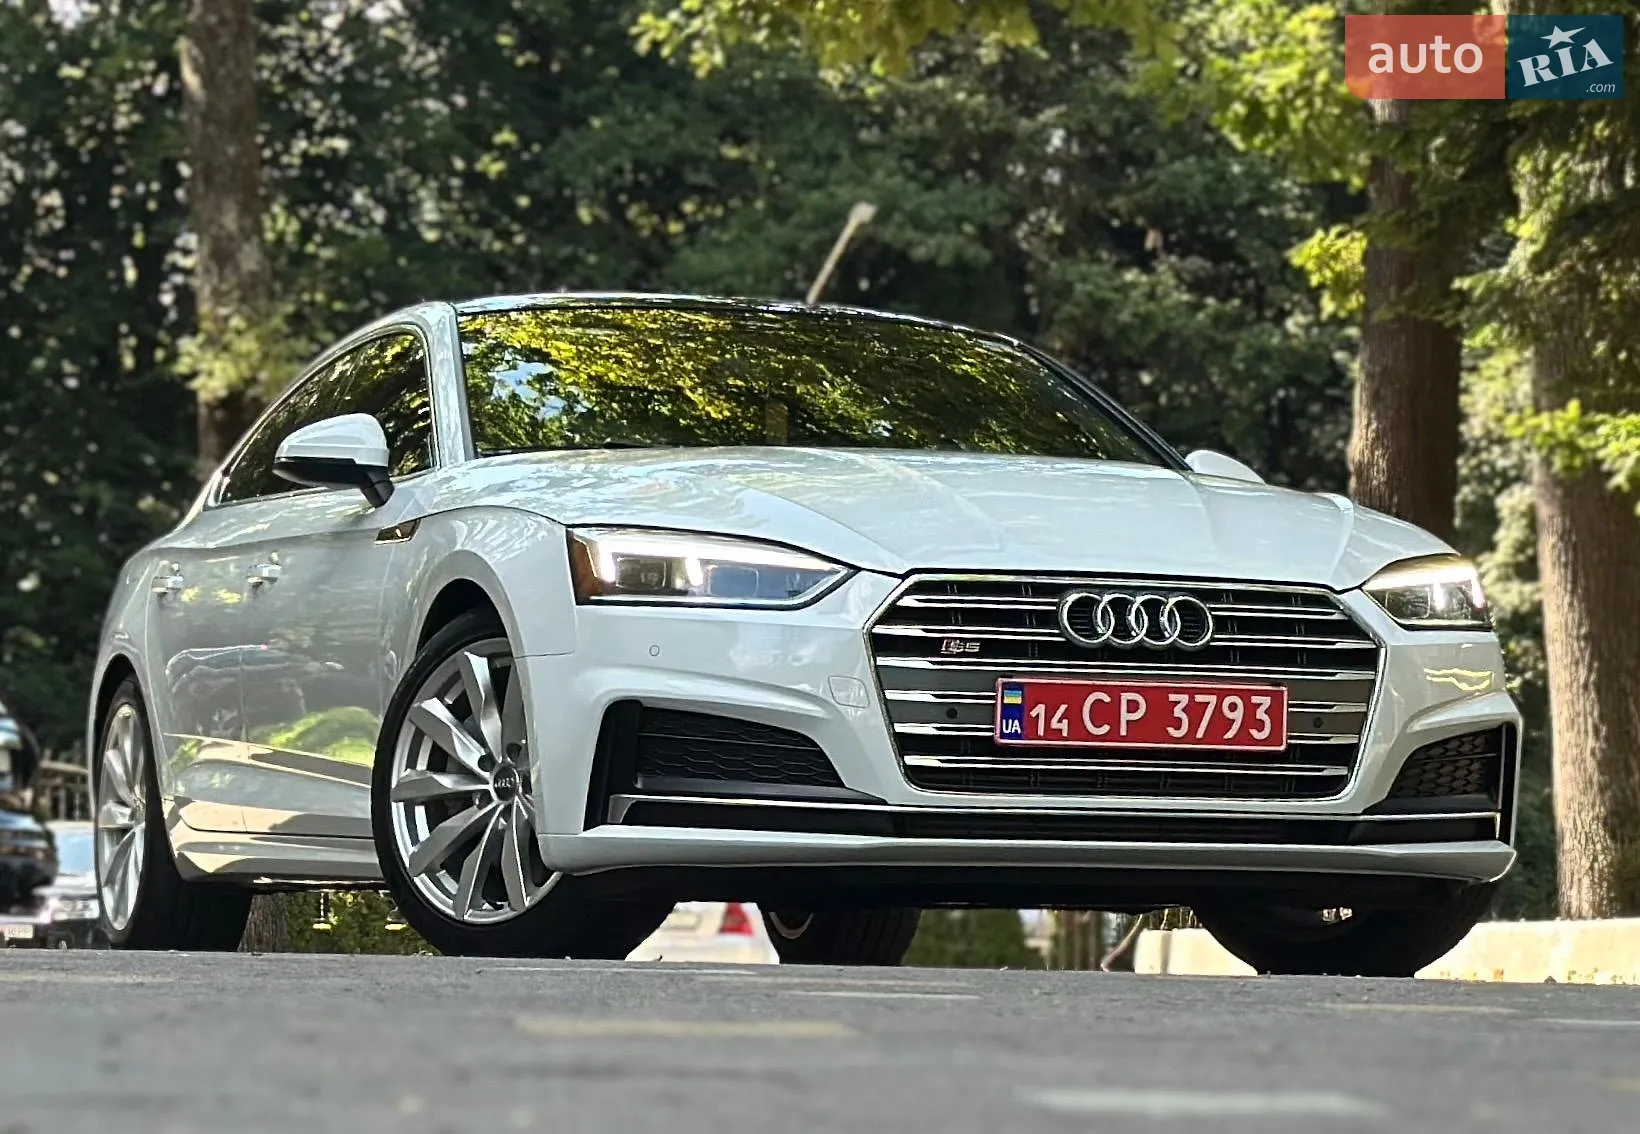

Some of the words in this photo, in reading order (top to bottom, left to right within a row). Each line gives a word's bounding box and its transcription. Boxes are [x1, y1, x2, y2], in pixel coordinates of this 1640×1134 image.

[1002, 718, 1022, 735] UA
[1029, 703, 1069, 737] 14
[1082, 692, 1147, 736] CP
[1166, 693, 1272, 740] 3793
